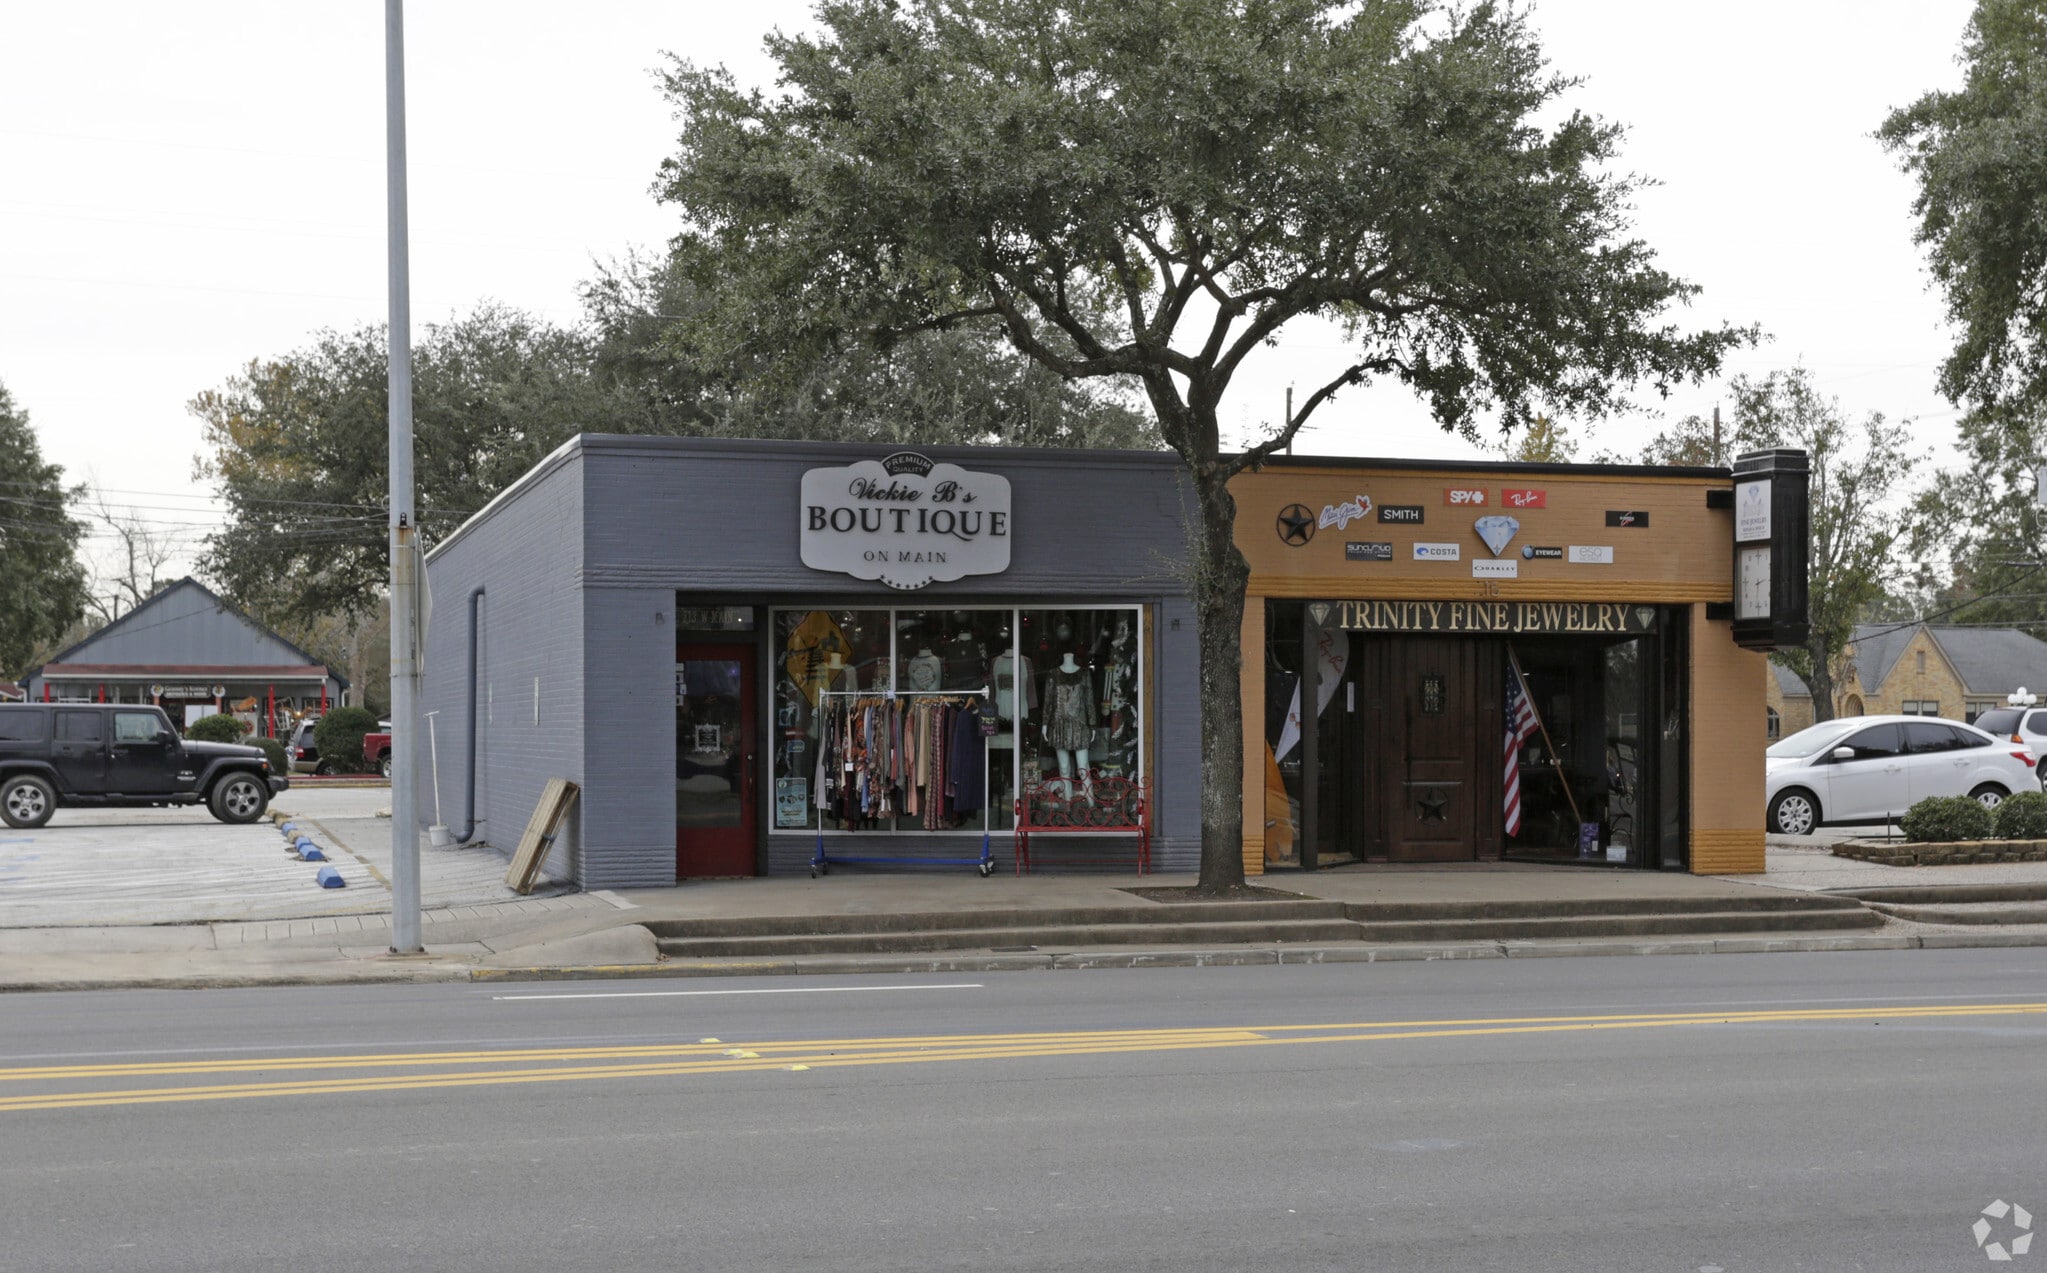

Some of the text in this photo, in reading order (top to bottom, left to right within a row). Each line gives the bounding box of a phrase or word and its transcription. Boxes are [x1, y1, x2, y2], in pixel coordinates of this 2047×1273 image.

[886, 456, 932, 470] PREMIUM
[849, 477, 977, 503] Vickie B's
[1384, 509, 1419, 520] SMITH
[807, 506, 1007, 541] BOUTIQUE
[863, 550, 947, 563] ON MAIN
[1430, 548, 1457, 557] COSTA
[1336, 601, 1631, 632] TRINITY FINE JEWELRY
